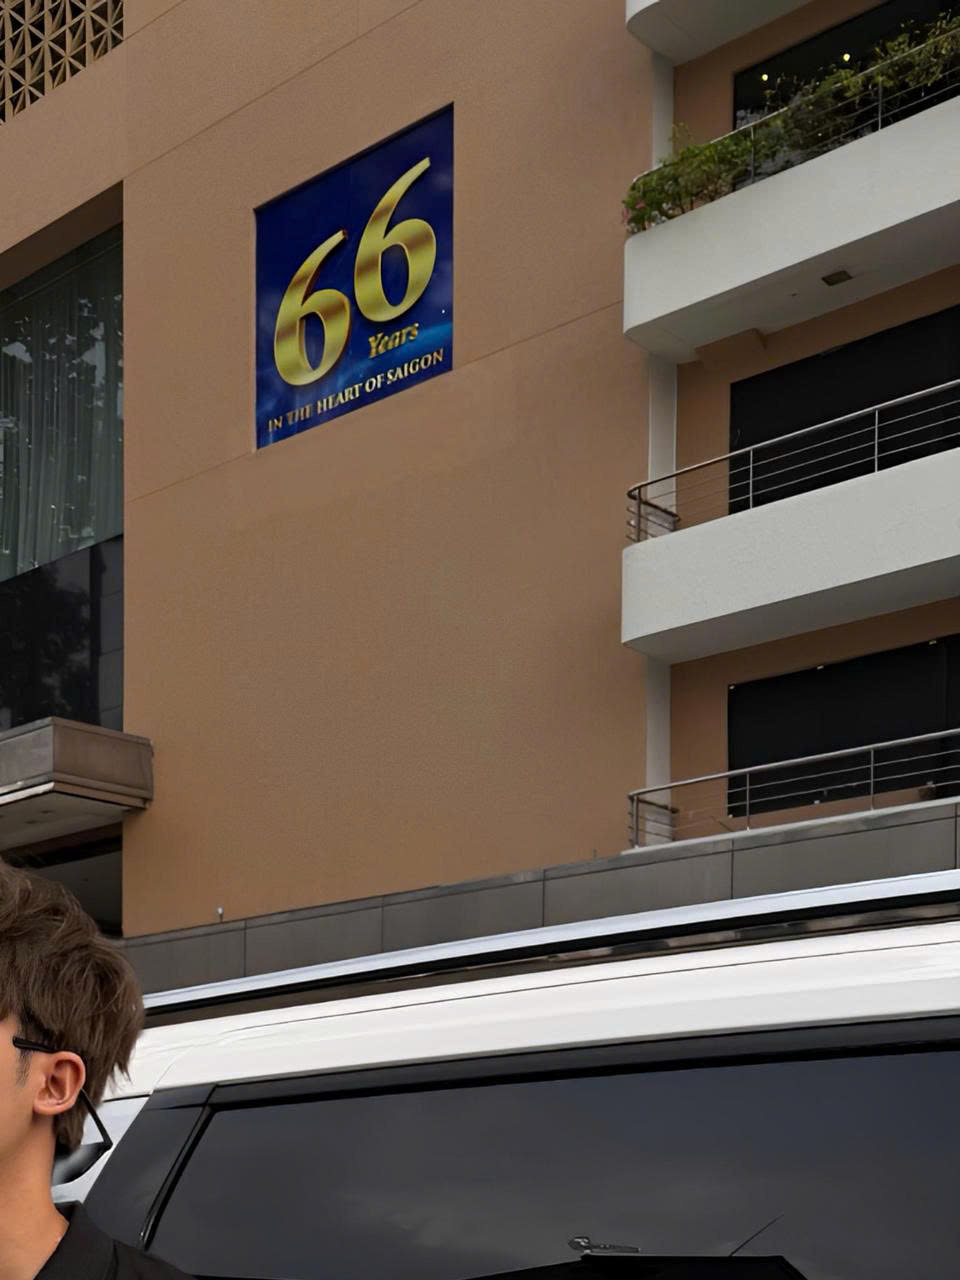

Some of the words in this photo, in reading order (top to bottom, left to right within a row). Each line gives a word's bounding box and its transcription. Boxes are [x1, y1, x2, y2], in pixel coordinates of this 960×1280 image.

[274, 157, 437, 386] 66
[368, 323, 420, 359] Years
[268, 416, 283, 432] IN
[286, 404, 313, 425] THE
[316, 383, 363, 415] HEART
[365, 373, 385, 393] OF
[386, 348, 444, 385] SAIGON
